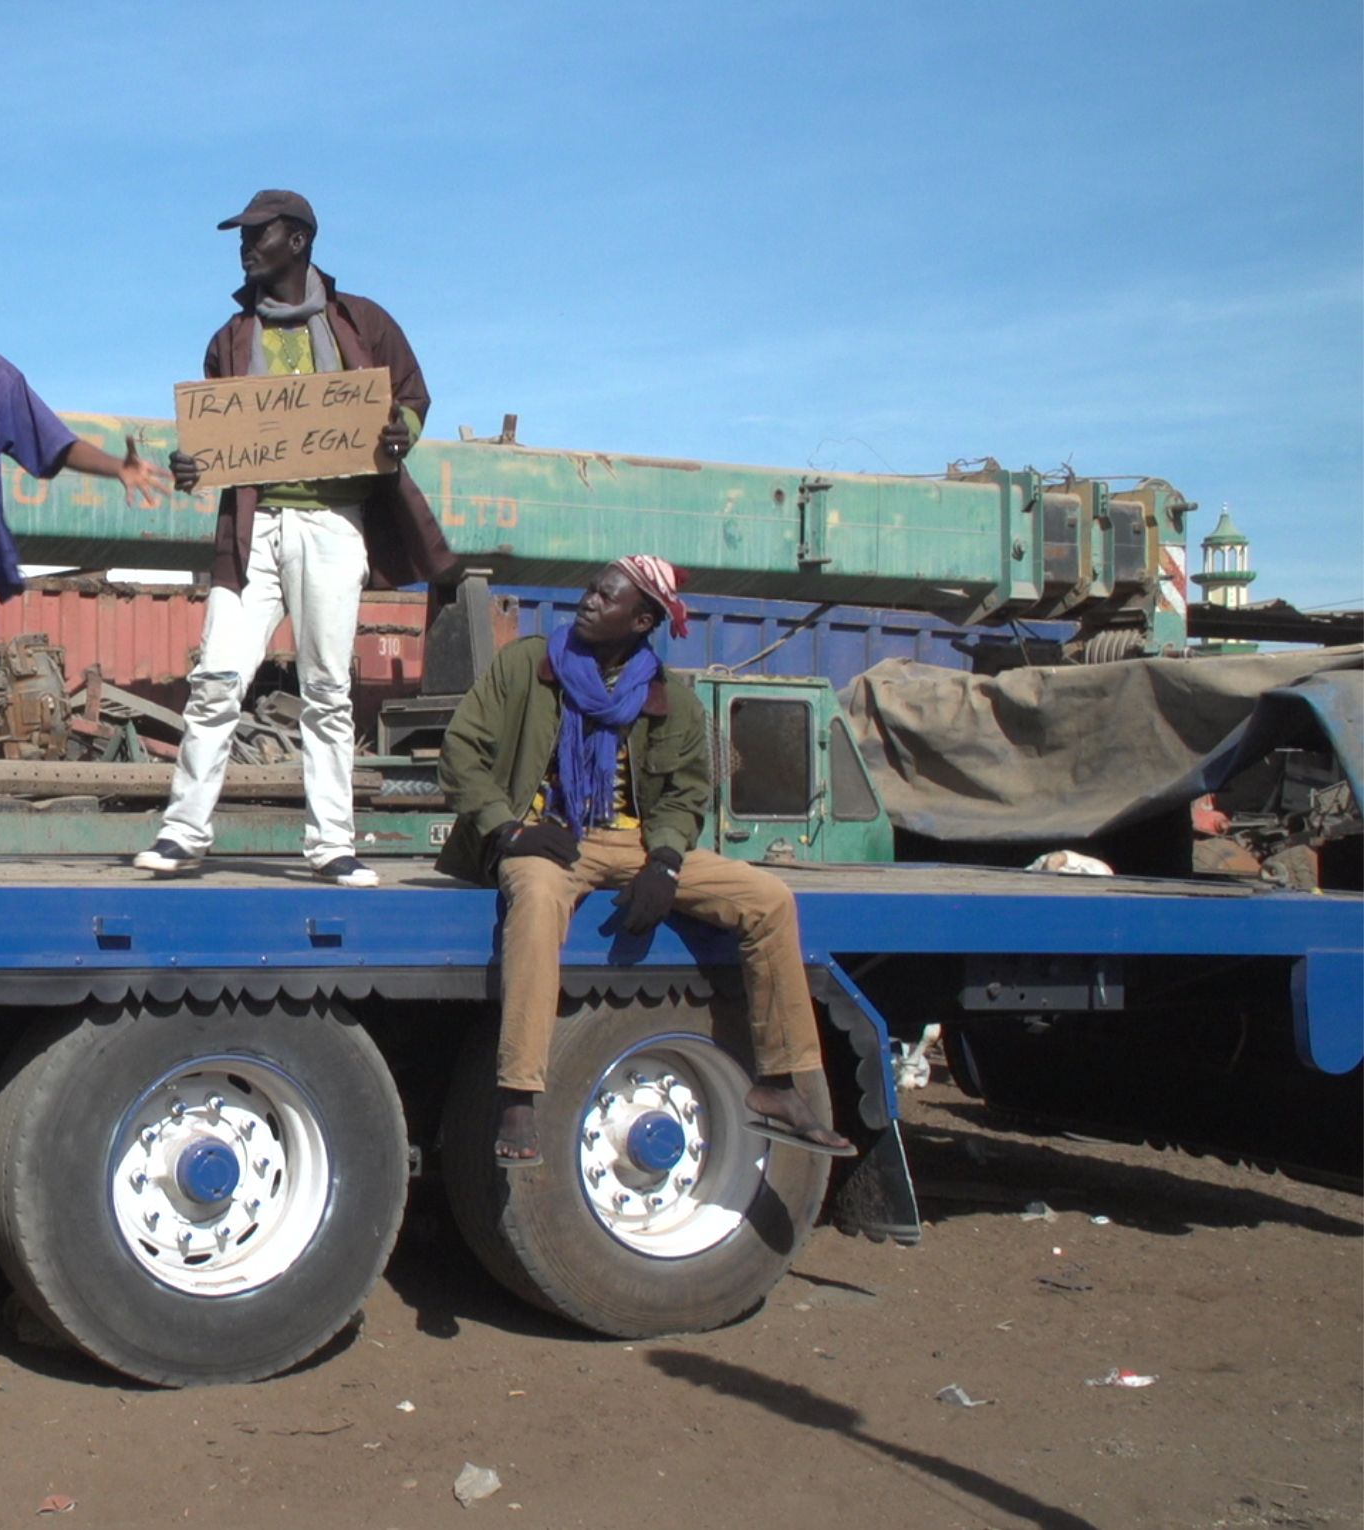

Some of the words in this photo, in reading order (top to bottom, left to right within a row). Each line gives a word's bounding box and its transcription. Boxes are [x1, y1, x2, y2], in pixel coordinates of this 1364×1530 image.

[322, 379, 381, 408] EGAL
[301, 427, 367, 455] EGAL
[378, 636, 401, 657] 310
